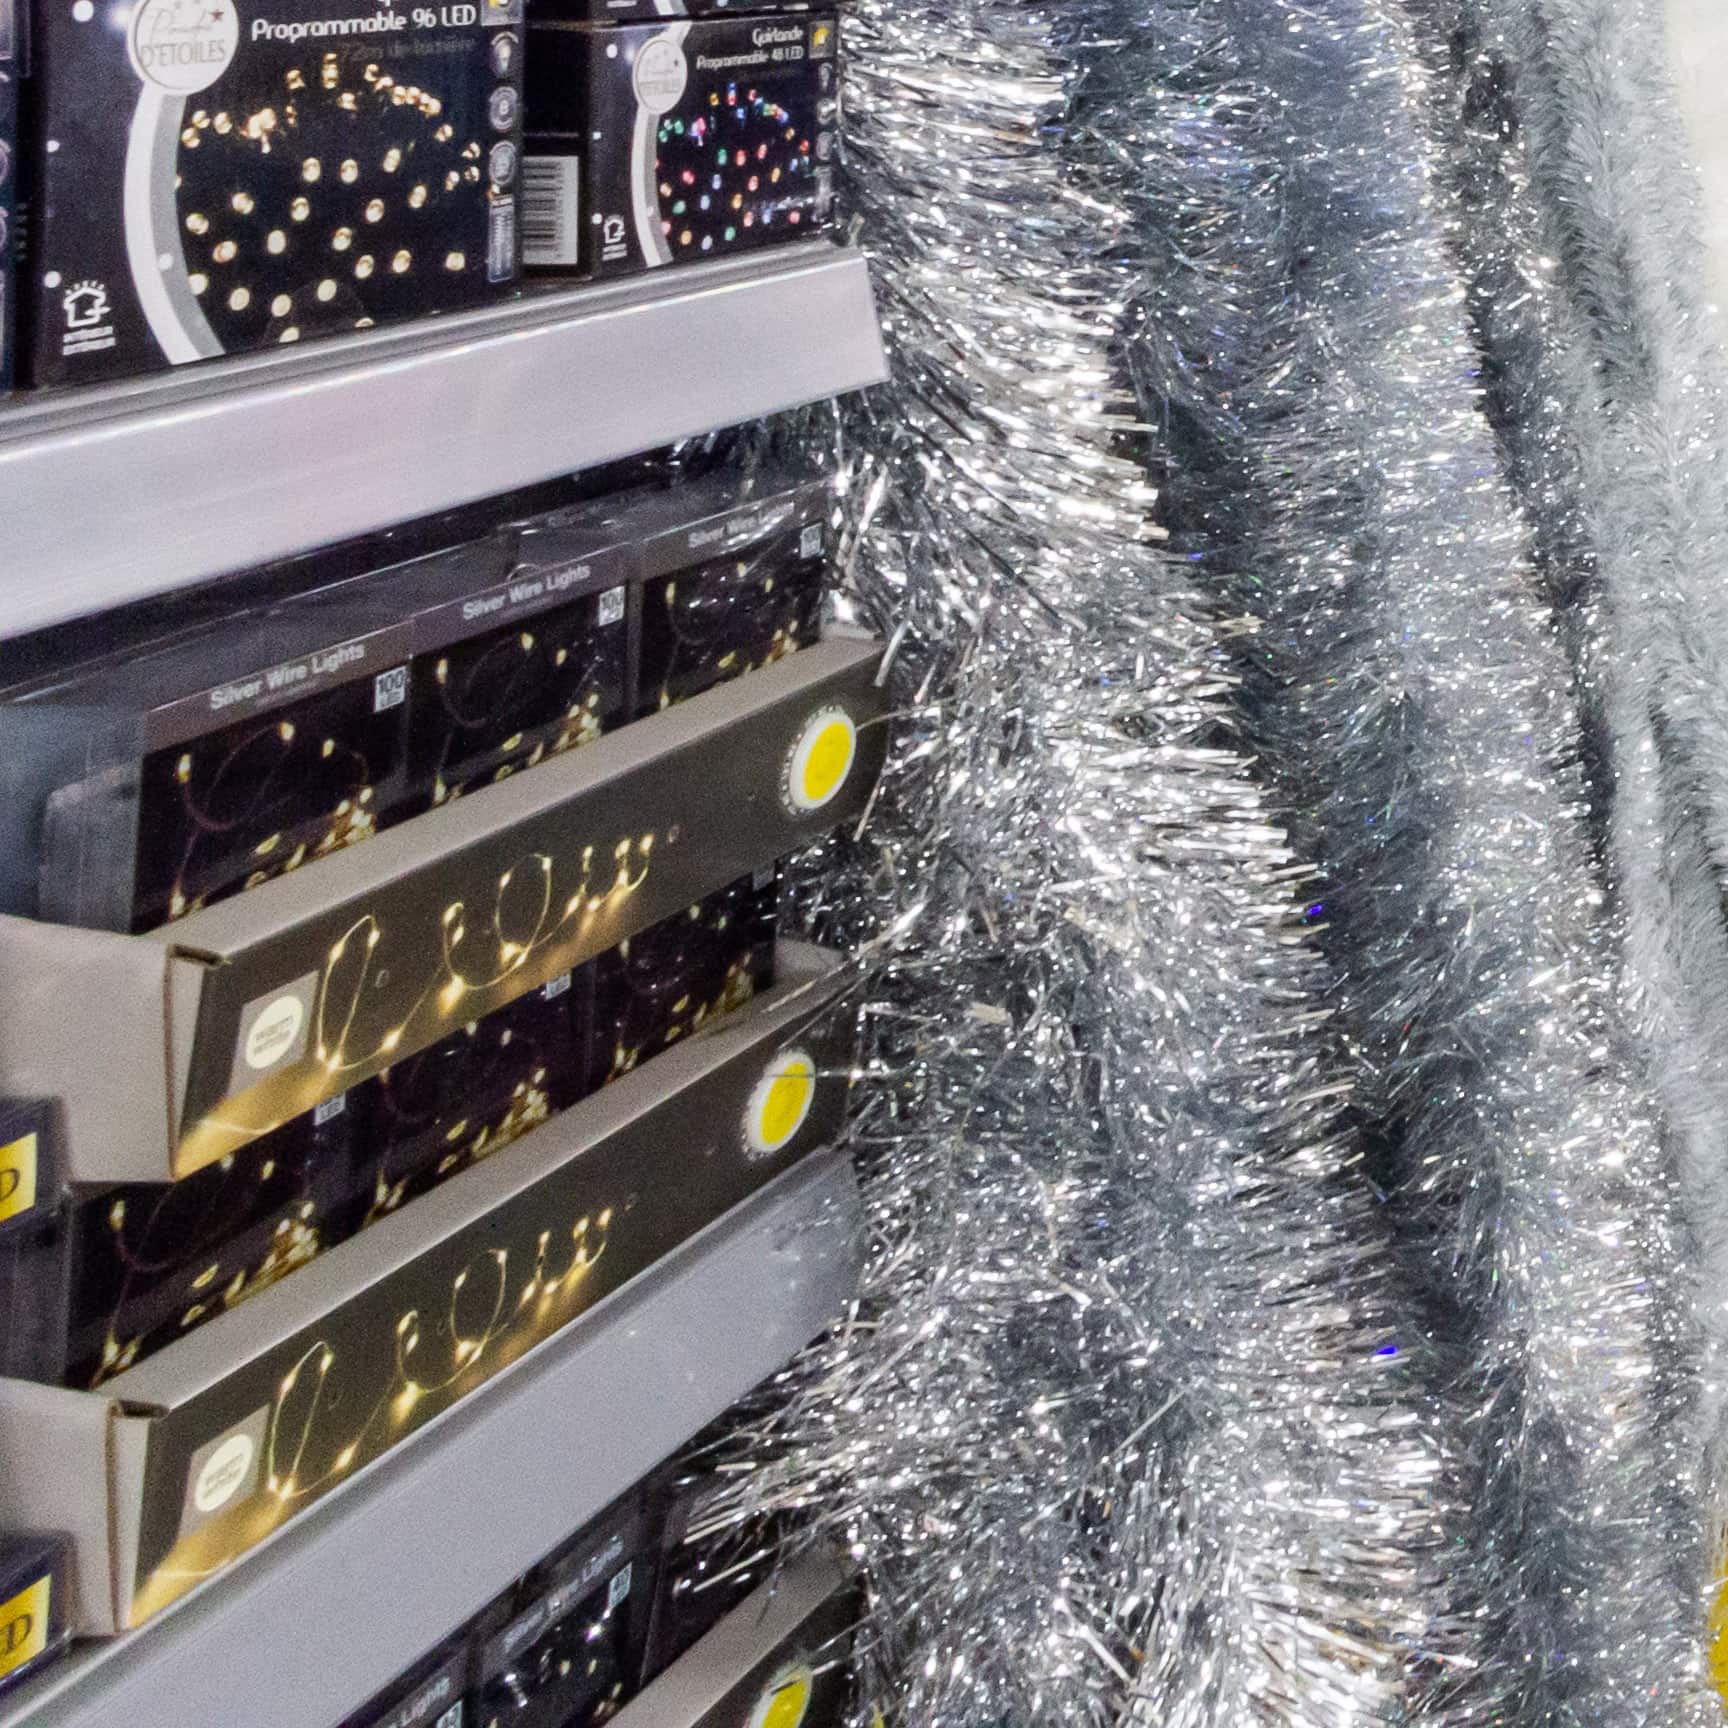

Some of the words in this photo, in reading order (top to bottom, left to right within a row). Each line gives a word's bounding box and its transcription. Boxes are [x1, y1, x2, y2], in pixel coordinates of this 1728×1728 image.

[251, 10, 408, 44] Programmable
[411, 8, 437, 29] 96
[440, 5, 477, 28] LED
[752, 27, 804, 48] Guirlande
[462, 594, 506, 621] Silver
[510, 581, 544, 604] Wire
[545, 564, 591, 591] Lights
[209, 679, 264, 711] Silver
[266, 664, 308, 689] Wire
[311, 643, 366, 674] Lights
